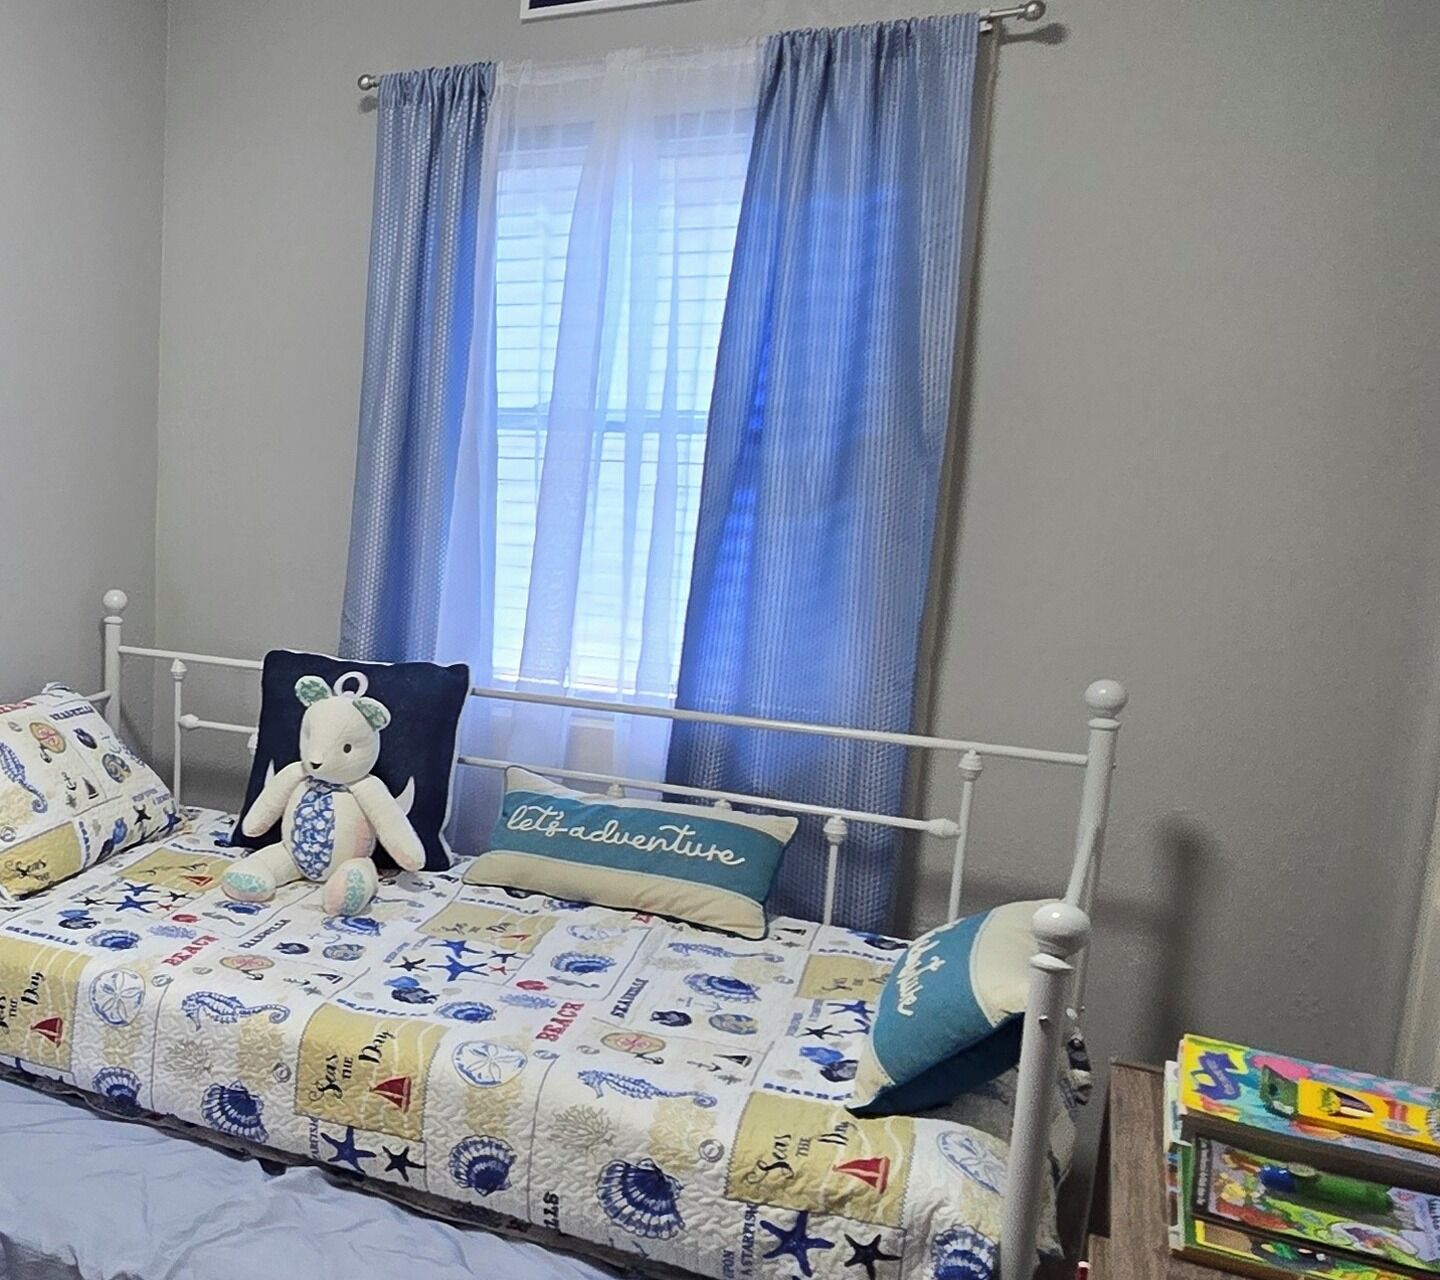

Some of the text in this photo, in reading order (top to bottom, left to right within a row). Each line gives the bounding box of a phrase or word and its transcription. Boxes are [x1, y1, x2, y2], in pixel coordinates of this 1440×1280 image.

[506, 805, 746, 865] let's adventure
[161, 935, 220, 966] BEACH
[21, 970, 45, 1005] Day
[10, 998, 19, 1018] THE
[535, 1001, 585, 1042] BEACH
[358, 1031, 397, 1064] Day
[309, 1053, 344, 1102] Seas
[342, 1056, 354, 1080] THE
[745, 1134, 795, 1185] Seas
[795, 1136, 812, 1157] THE
